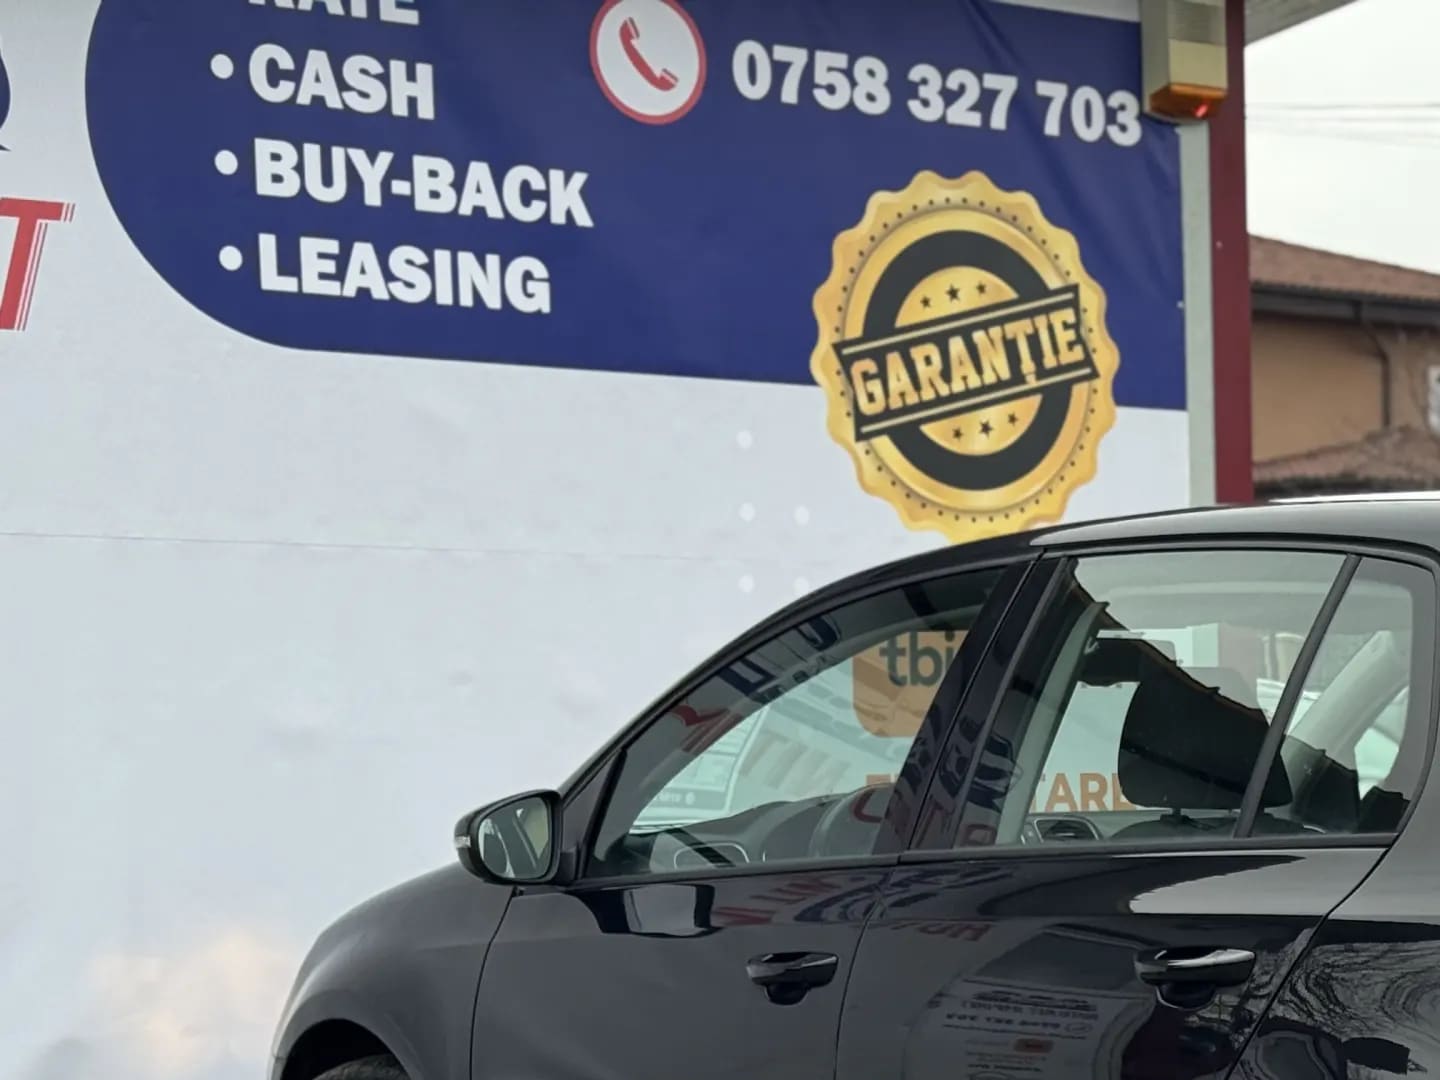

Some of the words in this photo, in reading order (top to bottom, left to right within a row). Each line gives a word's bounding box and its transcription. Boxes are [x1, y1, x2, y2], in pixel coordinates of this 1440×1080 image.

[249, 43, 435, 120] CASH
[732, 40, 891, 115] 0758
[907, 63, 1018, 131] 327
[1035, 80, 1142, 146] 703
[254, 138, 594, 227] BUY-BACK
[258, 233, 551, 313] LEASING
